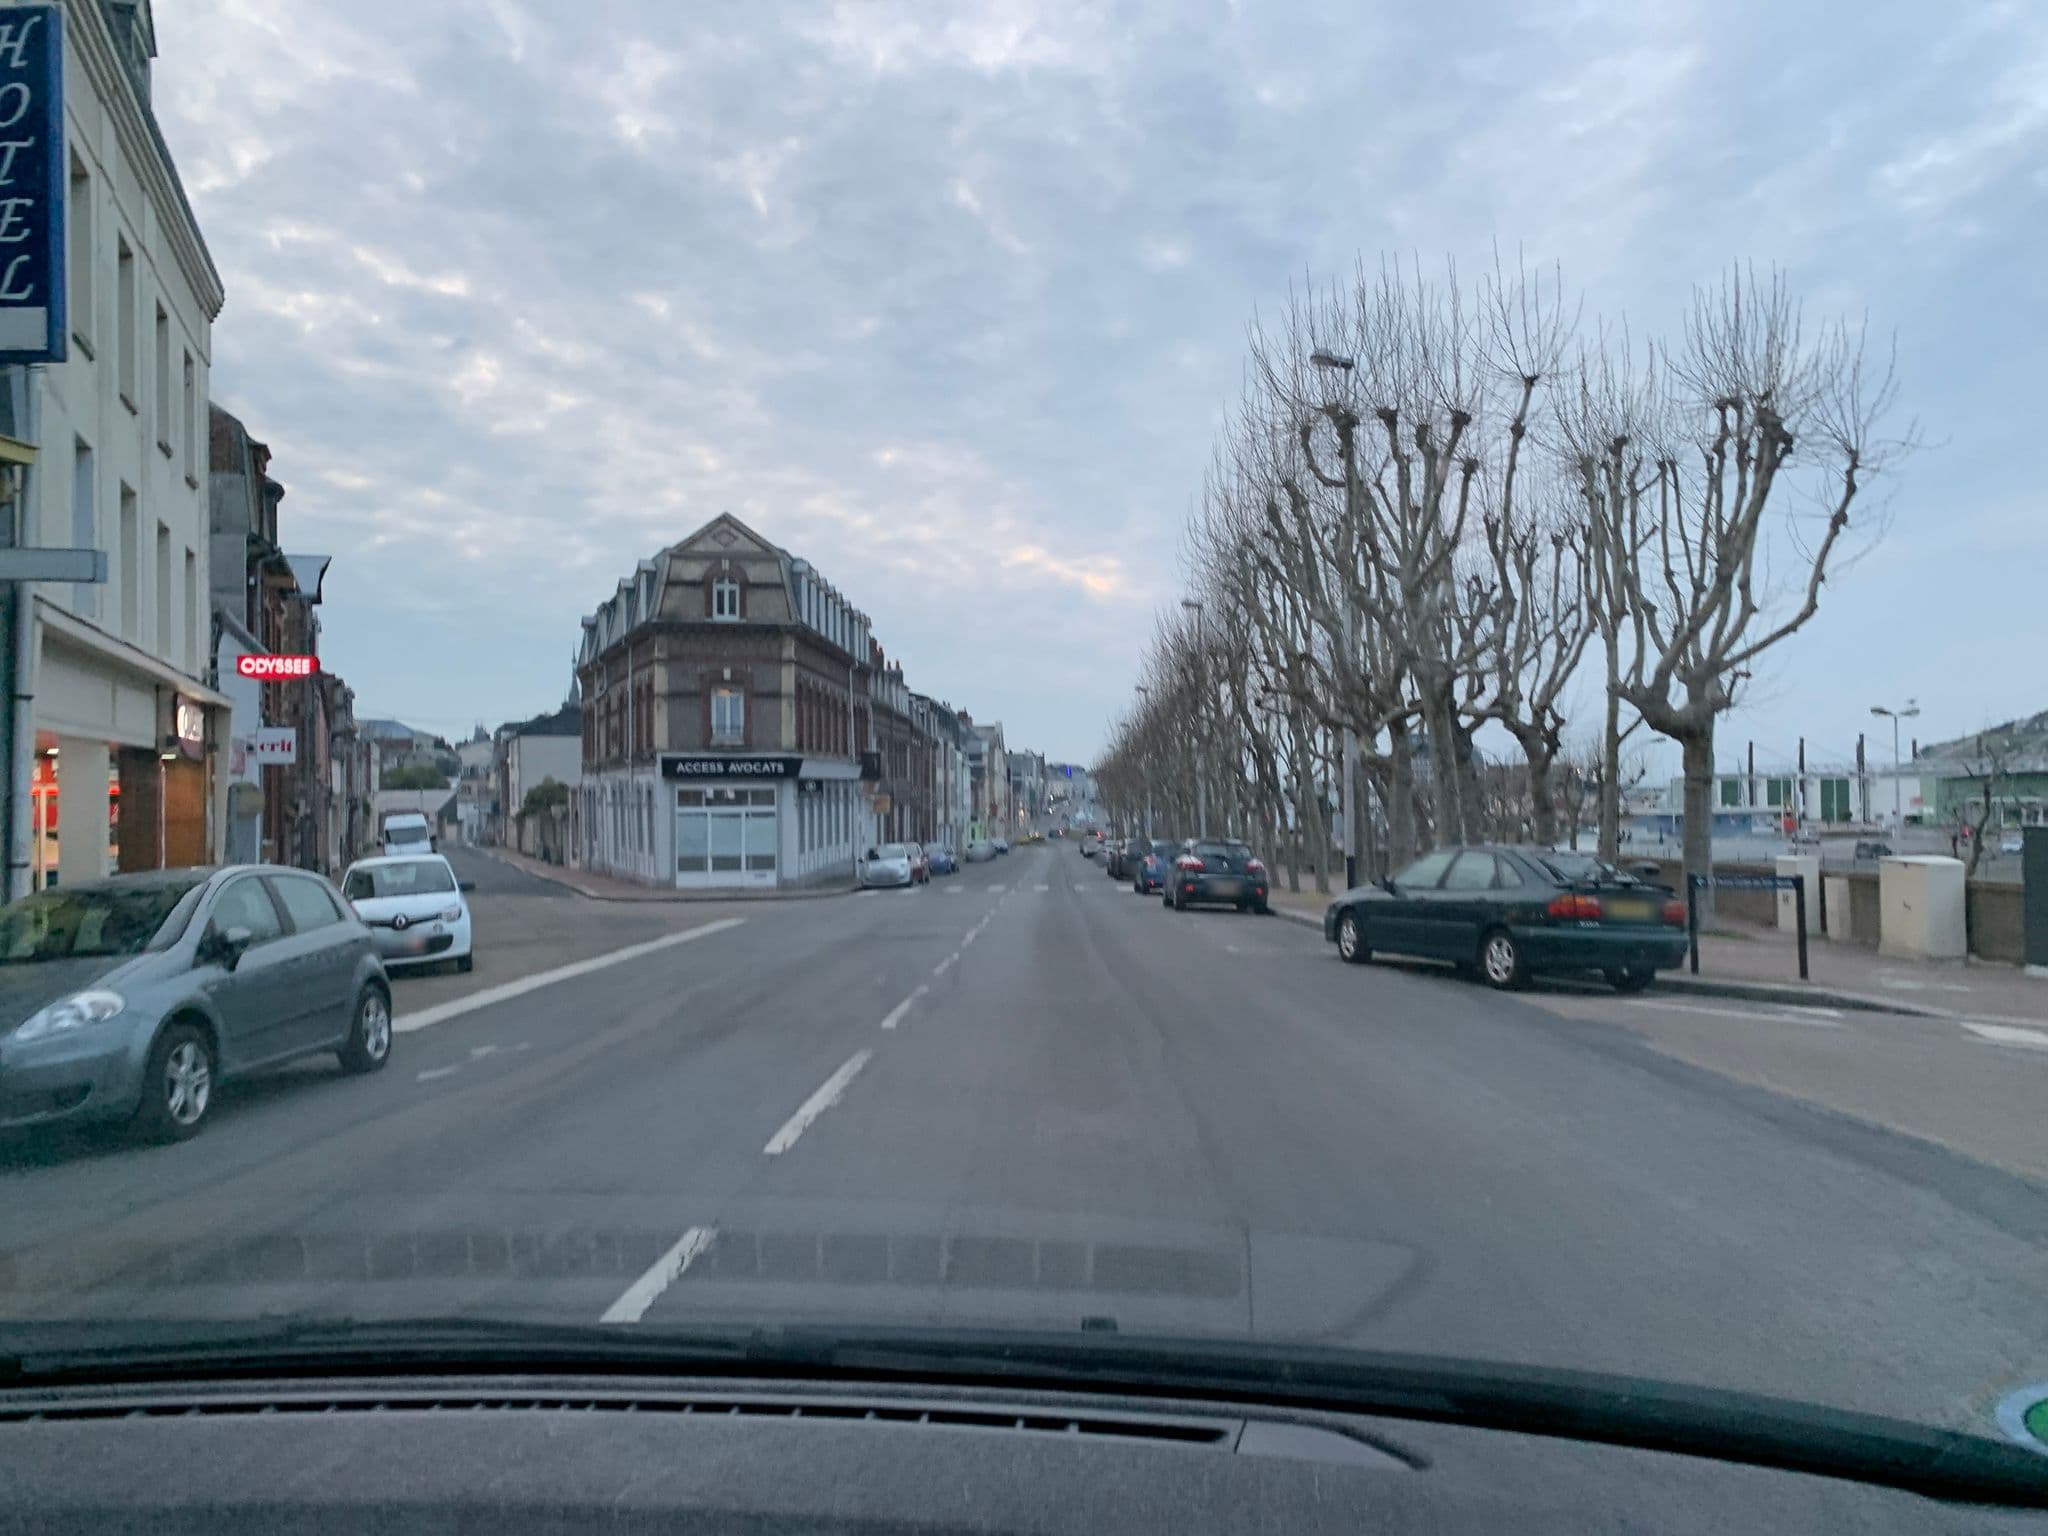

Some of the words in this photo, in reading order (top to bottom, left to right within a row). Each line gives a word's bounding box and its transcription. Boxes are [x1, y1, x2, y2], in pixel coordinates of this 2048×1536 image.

[0, 15, 42, 300] HOTEL
[240, 658, 311, 674] ODYSSEE
[676, 761, 724, 774] ACCESS
[728, 761, 785, 774] AVOCATS
